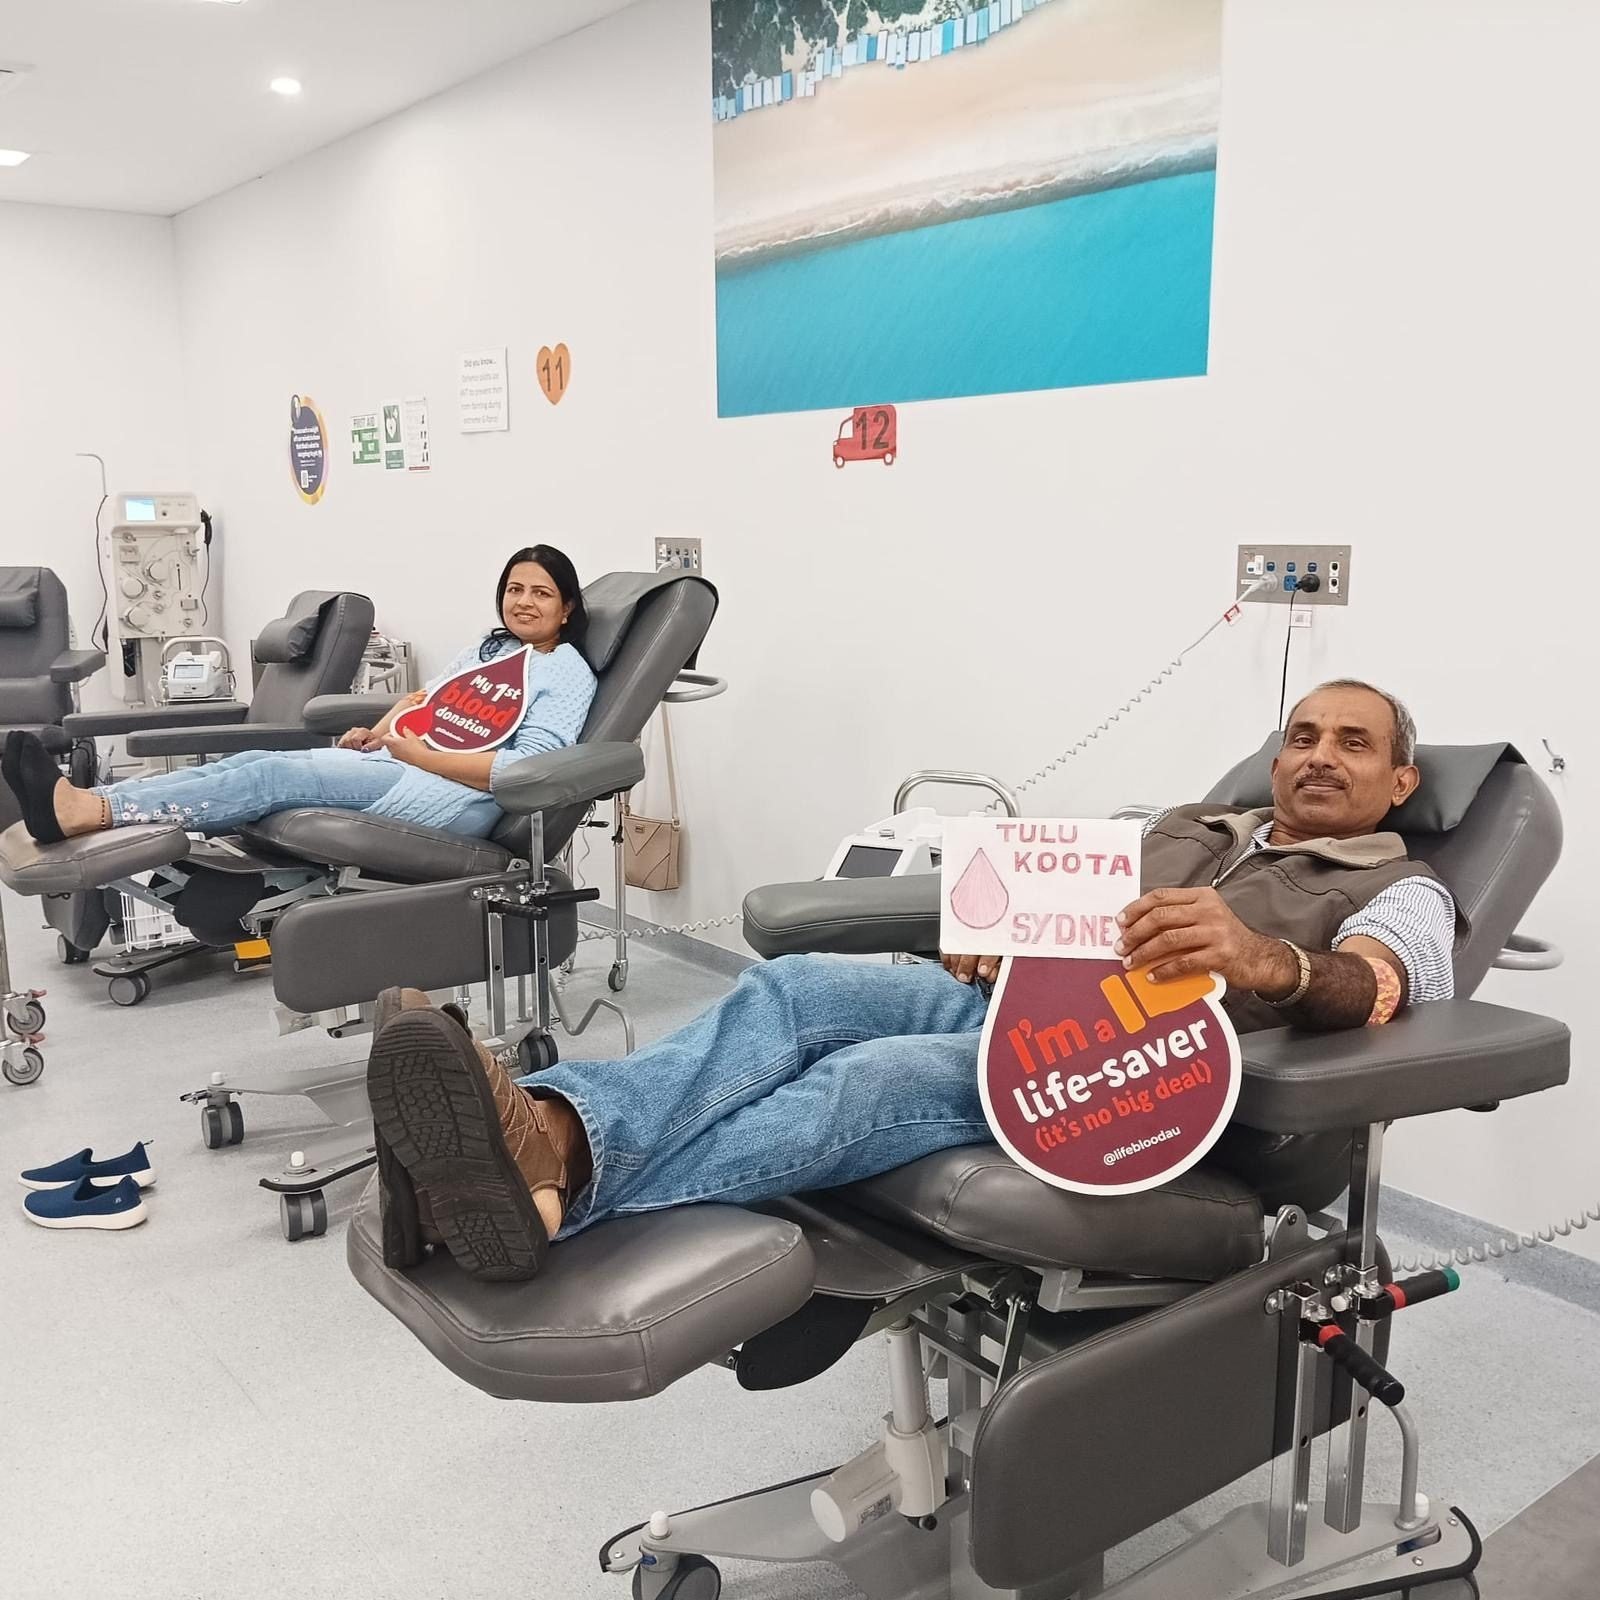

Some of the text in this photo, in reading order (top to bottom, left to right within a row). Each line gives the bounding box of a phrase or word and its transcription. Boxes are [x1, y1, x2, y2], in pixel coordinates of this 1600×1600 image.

[543, 356, 563, 392] 11
[856, 410, 890, 450] 12
[441, 682, 518, 728] blood
[470, 674, 522, 702] My 1st
[435, 706, 491, 738] donation
[996, 823, 1078, 843] TULU
[1014, 851, 1133, 876] KOOTA
[1011, 912, 1114, 947] SYDNE
[1007, 1018, 1116, 1074] I'm a
[1012, 1019, 1208, 1123] life-saver
[1035, 1059, 1212, 1152] (it's no big deal)
[1103, 1126, 1182, 1166] @lifebloodau
